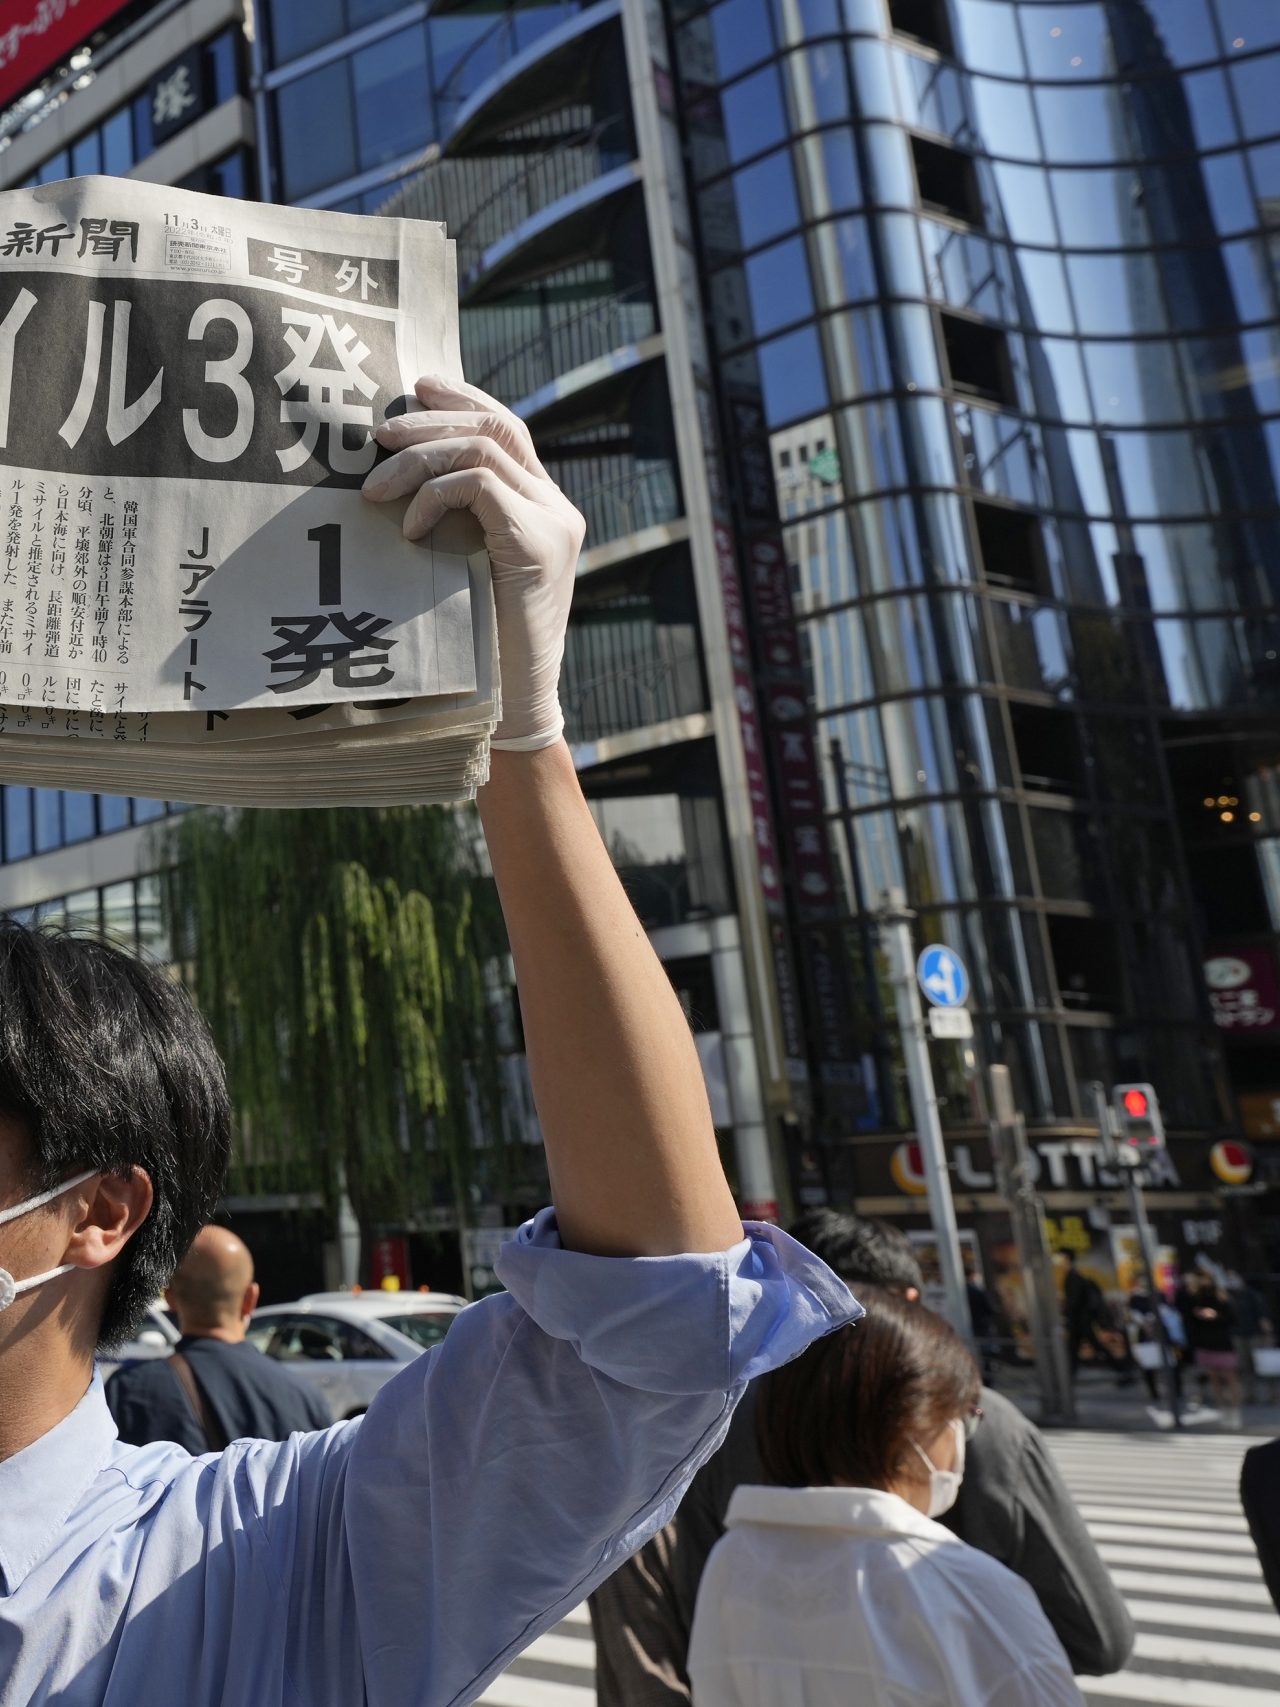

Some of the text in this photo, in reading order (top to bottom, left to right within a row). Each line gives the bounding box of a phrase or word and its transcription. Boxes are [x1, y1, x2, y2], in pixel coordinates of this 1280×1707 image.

[267, 245, 379, 301] 号外
[22, 481, 47, 657] ミサイルと推定されるミサイ
[116, 500, 139, 665] 韓国軍合同参謀本部による
[178, 526, 216, 701] Jアラート
[261, 522, 400, 695] 1発
